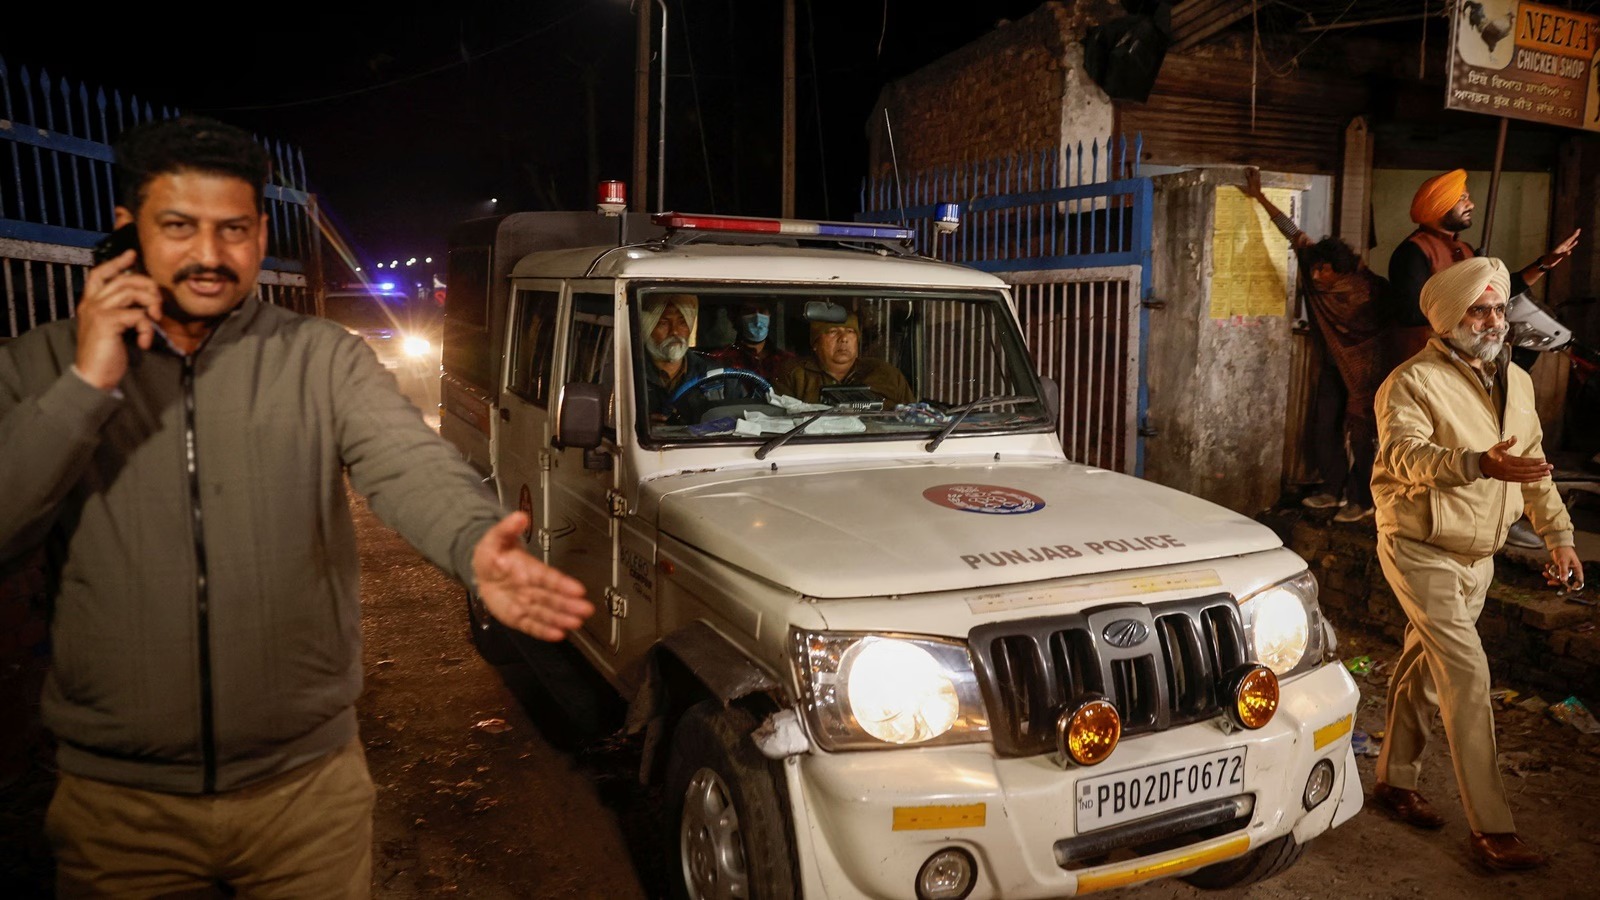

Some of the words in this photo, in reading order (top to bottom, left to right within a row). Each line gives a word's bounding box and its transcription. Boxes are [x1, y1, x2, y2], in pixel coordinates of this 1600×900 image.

[1521, 11, 1589, 50] NEETA
[1517, 49, 1557, 75] CHICKEN
[1559, 57, 1585, 79] SHOP
[960, 544, 1084, 570] PUNJAB
[1083, 534, 1187, 556] POLICE
[1097, 755, 1242, 818] PB02DF0672
[1079, 799, 1093, 811] IND
